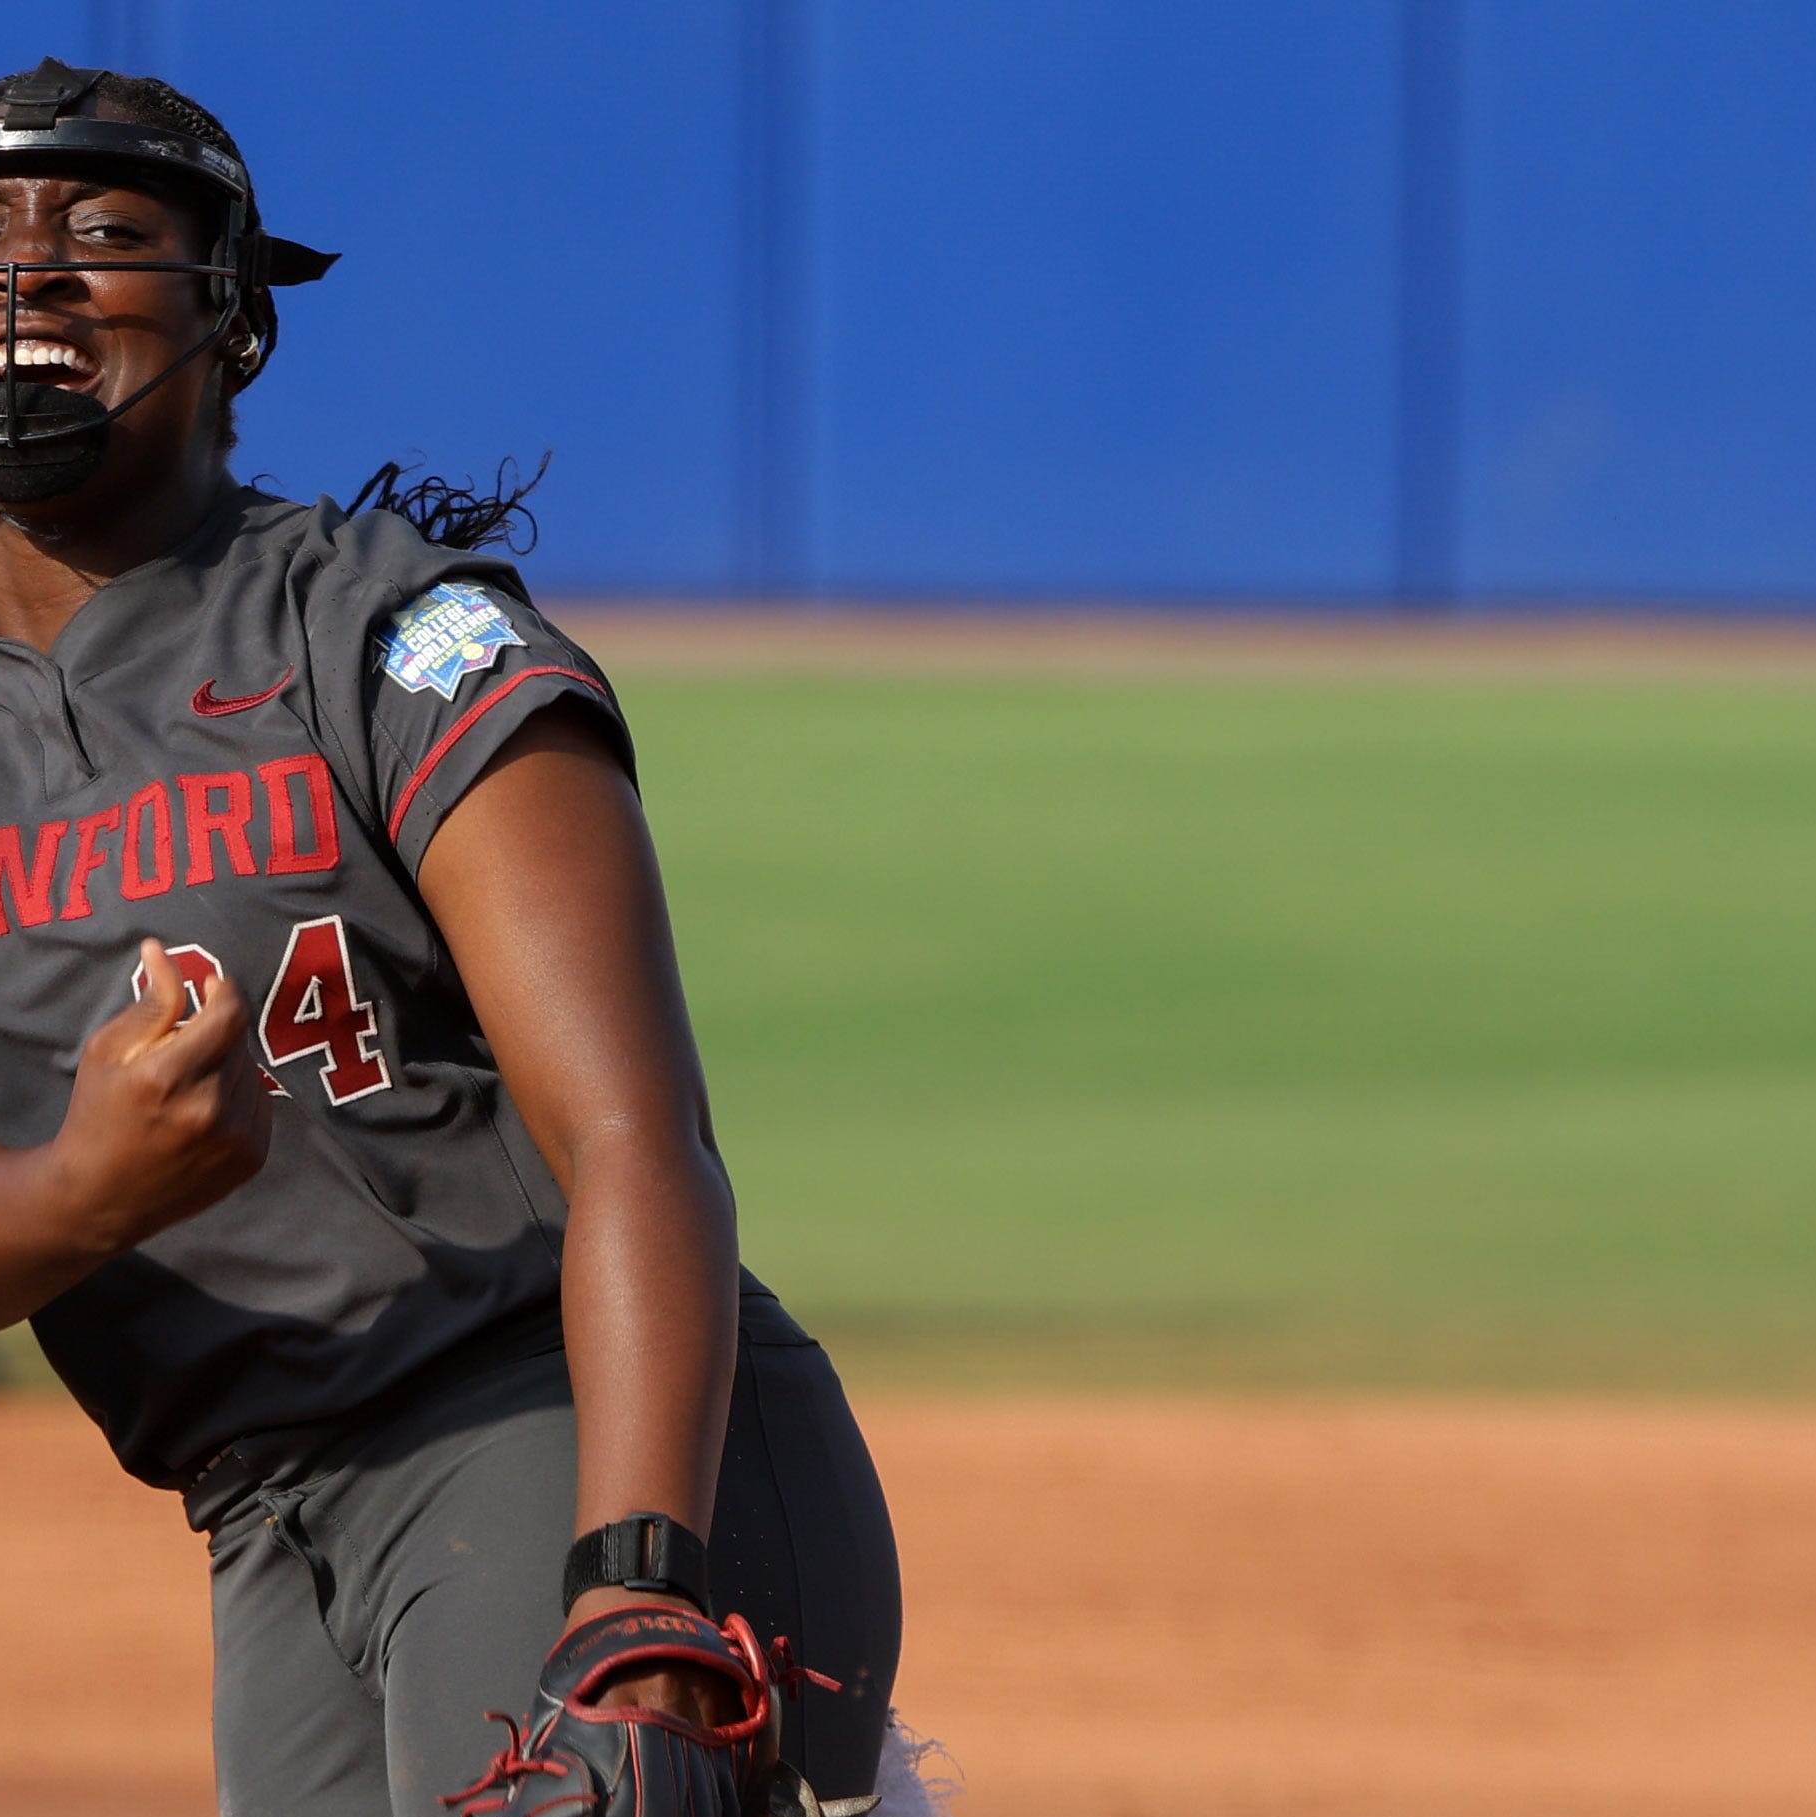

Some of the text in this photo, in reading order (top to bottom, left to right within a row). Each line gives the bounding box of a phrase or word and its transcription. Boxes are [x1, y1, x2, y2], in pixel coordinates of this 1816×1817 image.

[400, 605, 502, 683] WORLD SERIES
[406, 603, 470, 653] COLLEGE
[431, 623, 491, 670] OKLAHOMA CITY
